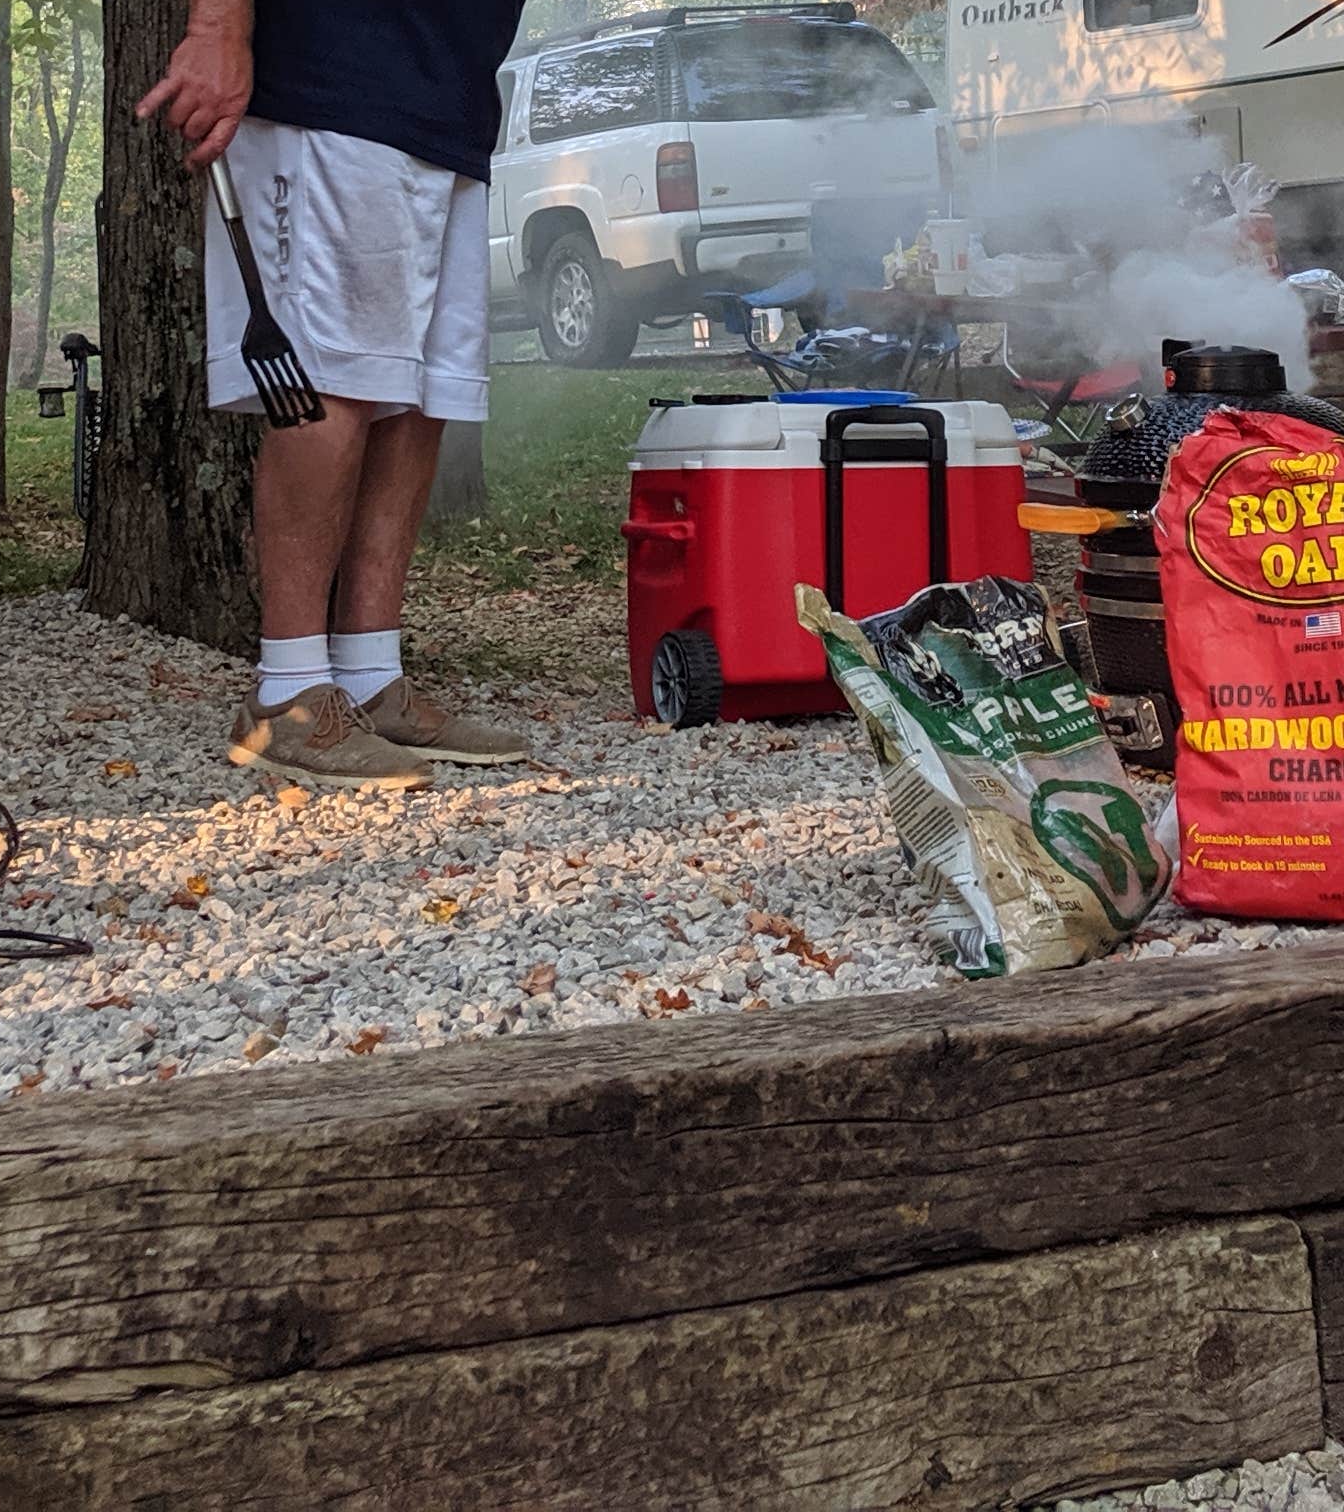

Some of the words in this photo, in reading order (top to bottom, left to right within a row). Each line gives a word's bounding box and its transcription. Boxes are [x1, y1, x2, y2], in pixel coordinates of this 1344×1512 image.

[1256, 613, 1287, 627] MADE
[1290, 618, 1302, 627] IN
[1293, 640, 1329, 654] SINCE
[1209, 684, 1277, 709] 100%
[1284, 681, 1331, 707] ALL
[1294, 791, 1309, 802] DE
[1194, 832, 1243, 847] Sustainably
[1244, 834, 1282, 846] Sourced
[1295, 835, 1311, 846] the
[1311, 834, 1332, 846] USA
[1202, 859, 1229, 872] Ready
[1230, 860, 1239, 871] to
[1240, 860, 1264, 872] Cook
[1275, 860, 1287, 872] 15
[1287, 861, 1327, 872] minutes
[1033, 899, 1084, 915] CHCOAL
